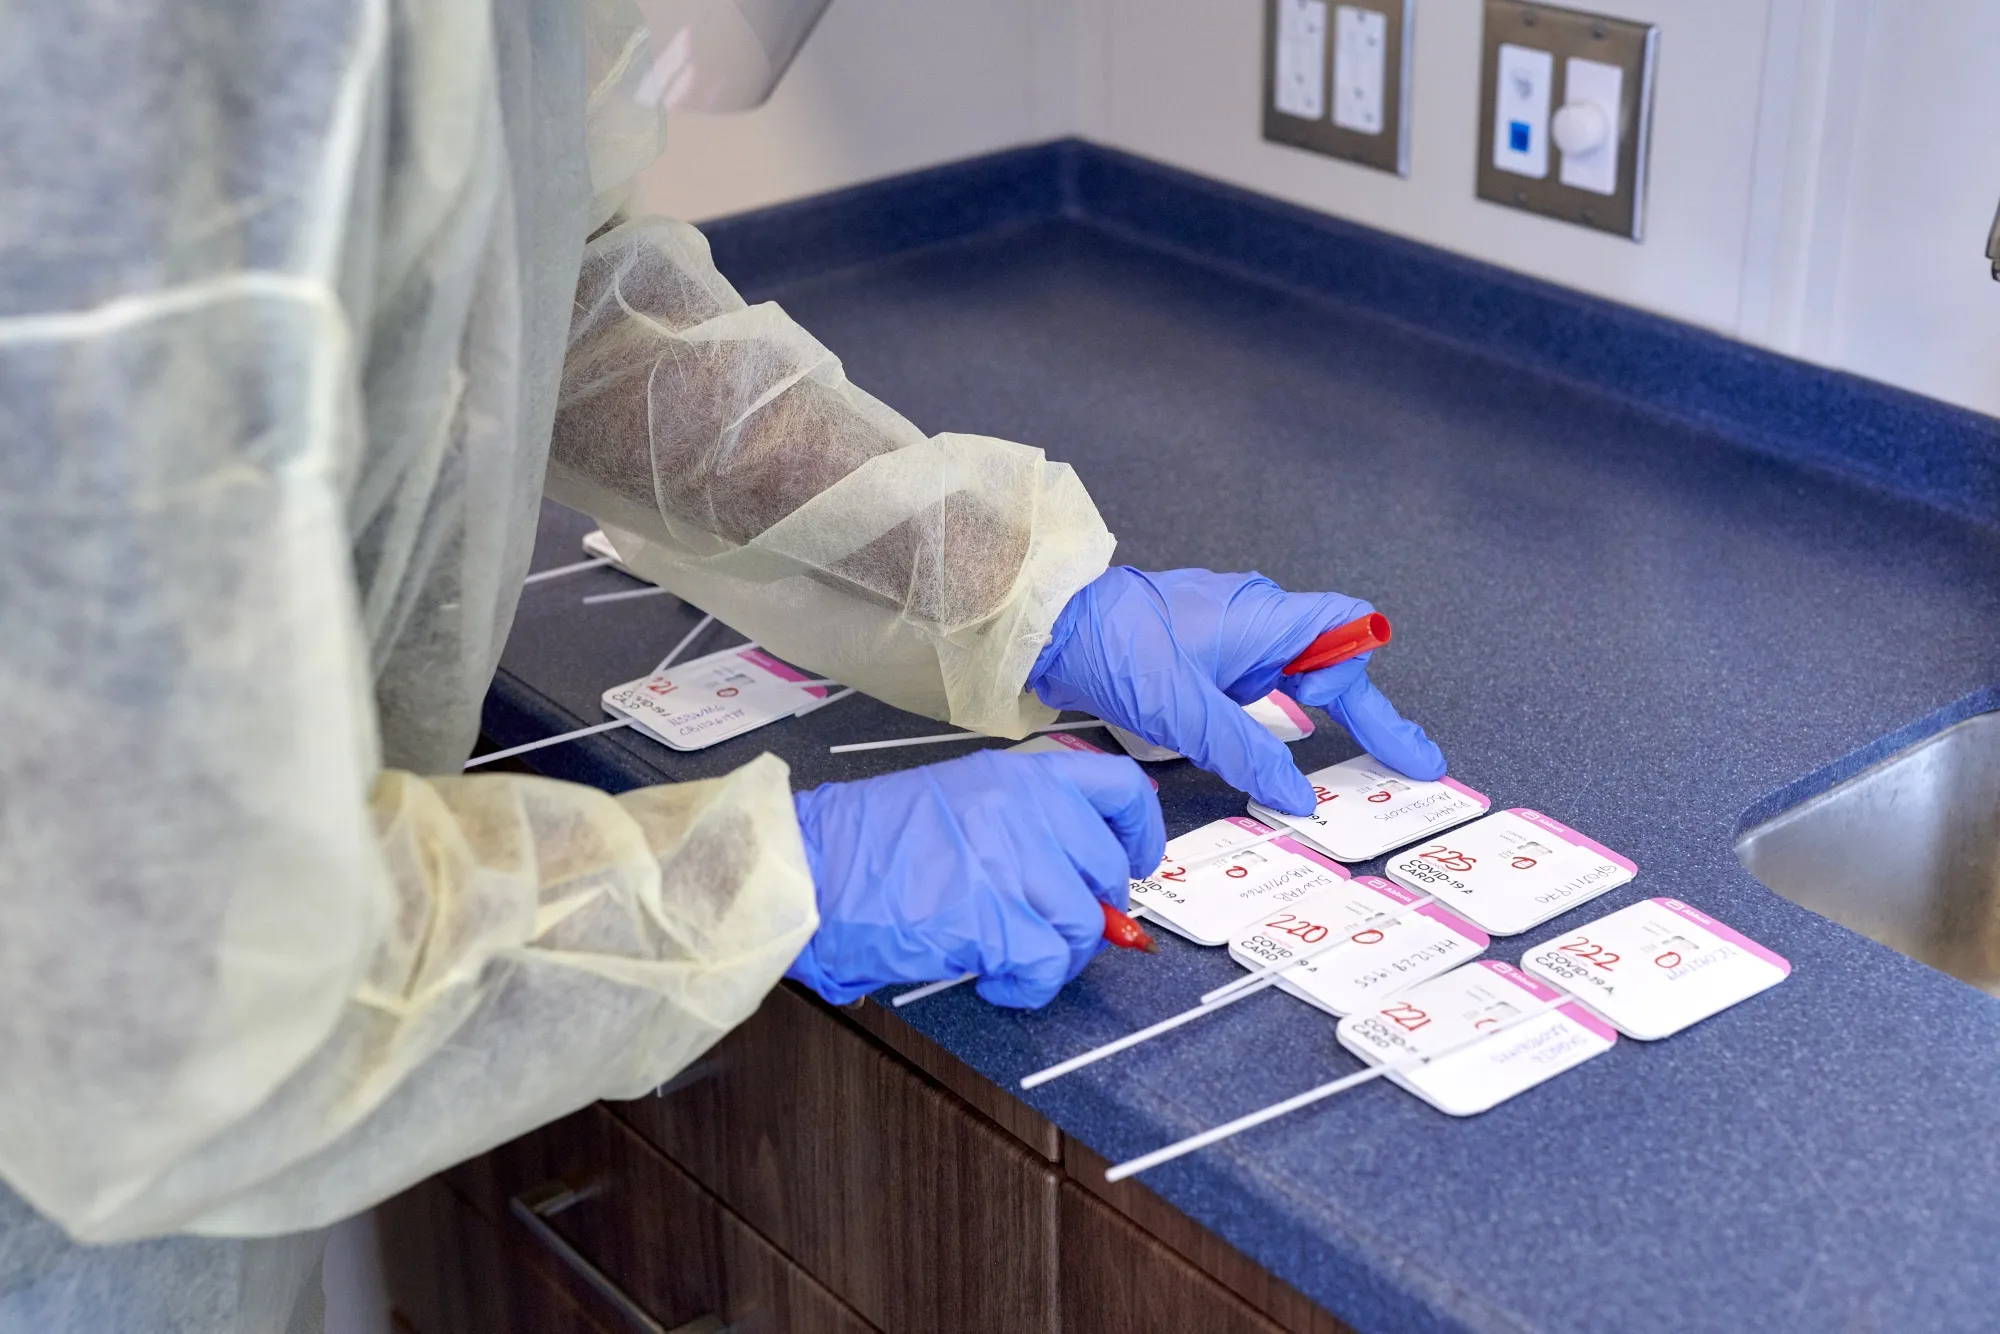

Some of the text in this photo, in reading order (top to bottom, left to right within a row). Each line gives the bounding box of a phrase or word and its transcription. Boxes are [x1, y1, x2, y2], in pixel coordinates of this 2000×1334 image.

[1538, 818, 1565, 833] Abbott
[1418, 845, 1477, 872] 225
[1399, 863, 1436, 884] CARD
[1409, 859, 1465, 889] COVID-19
[1384, 886, 1413, 902] Abbott
[1265, 913, 1328, 943] 220
[1241, 940, 1279, 961] CARD
[1558, 936, 1621, 972] 222
[1535, 956, 1574, 979] CARD
[1546, 952, 1606, 986] COVID-19
[1380, 1001, 1431, 1032] 221
